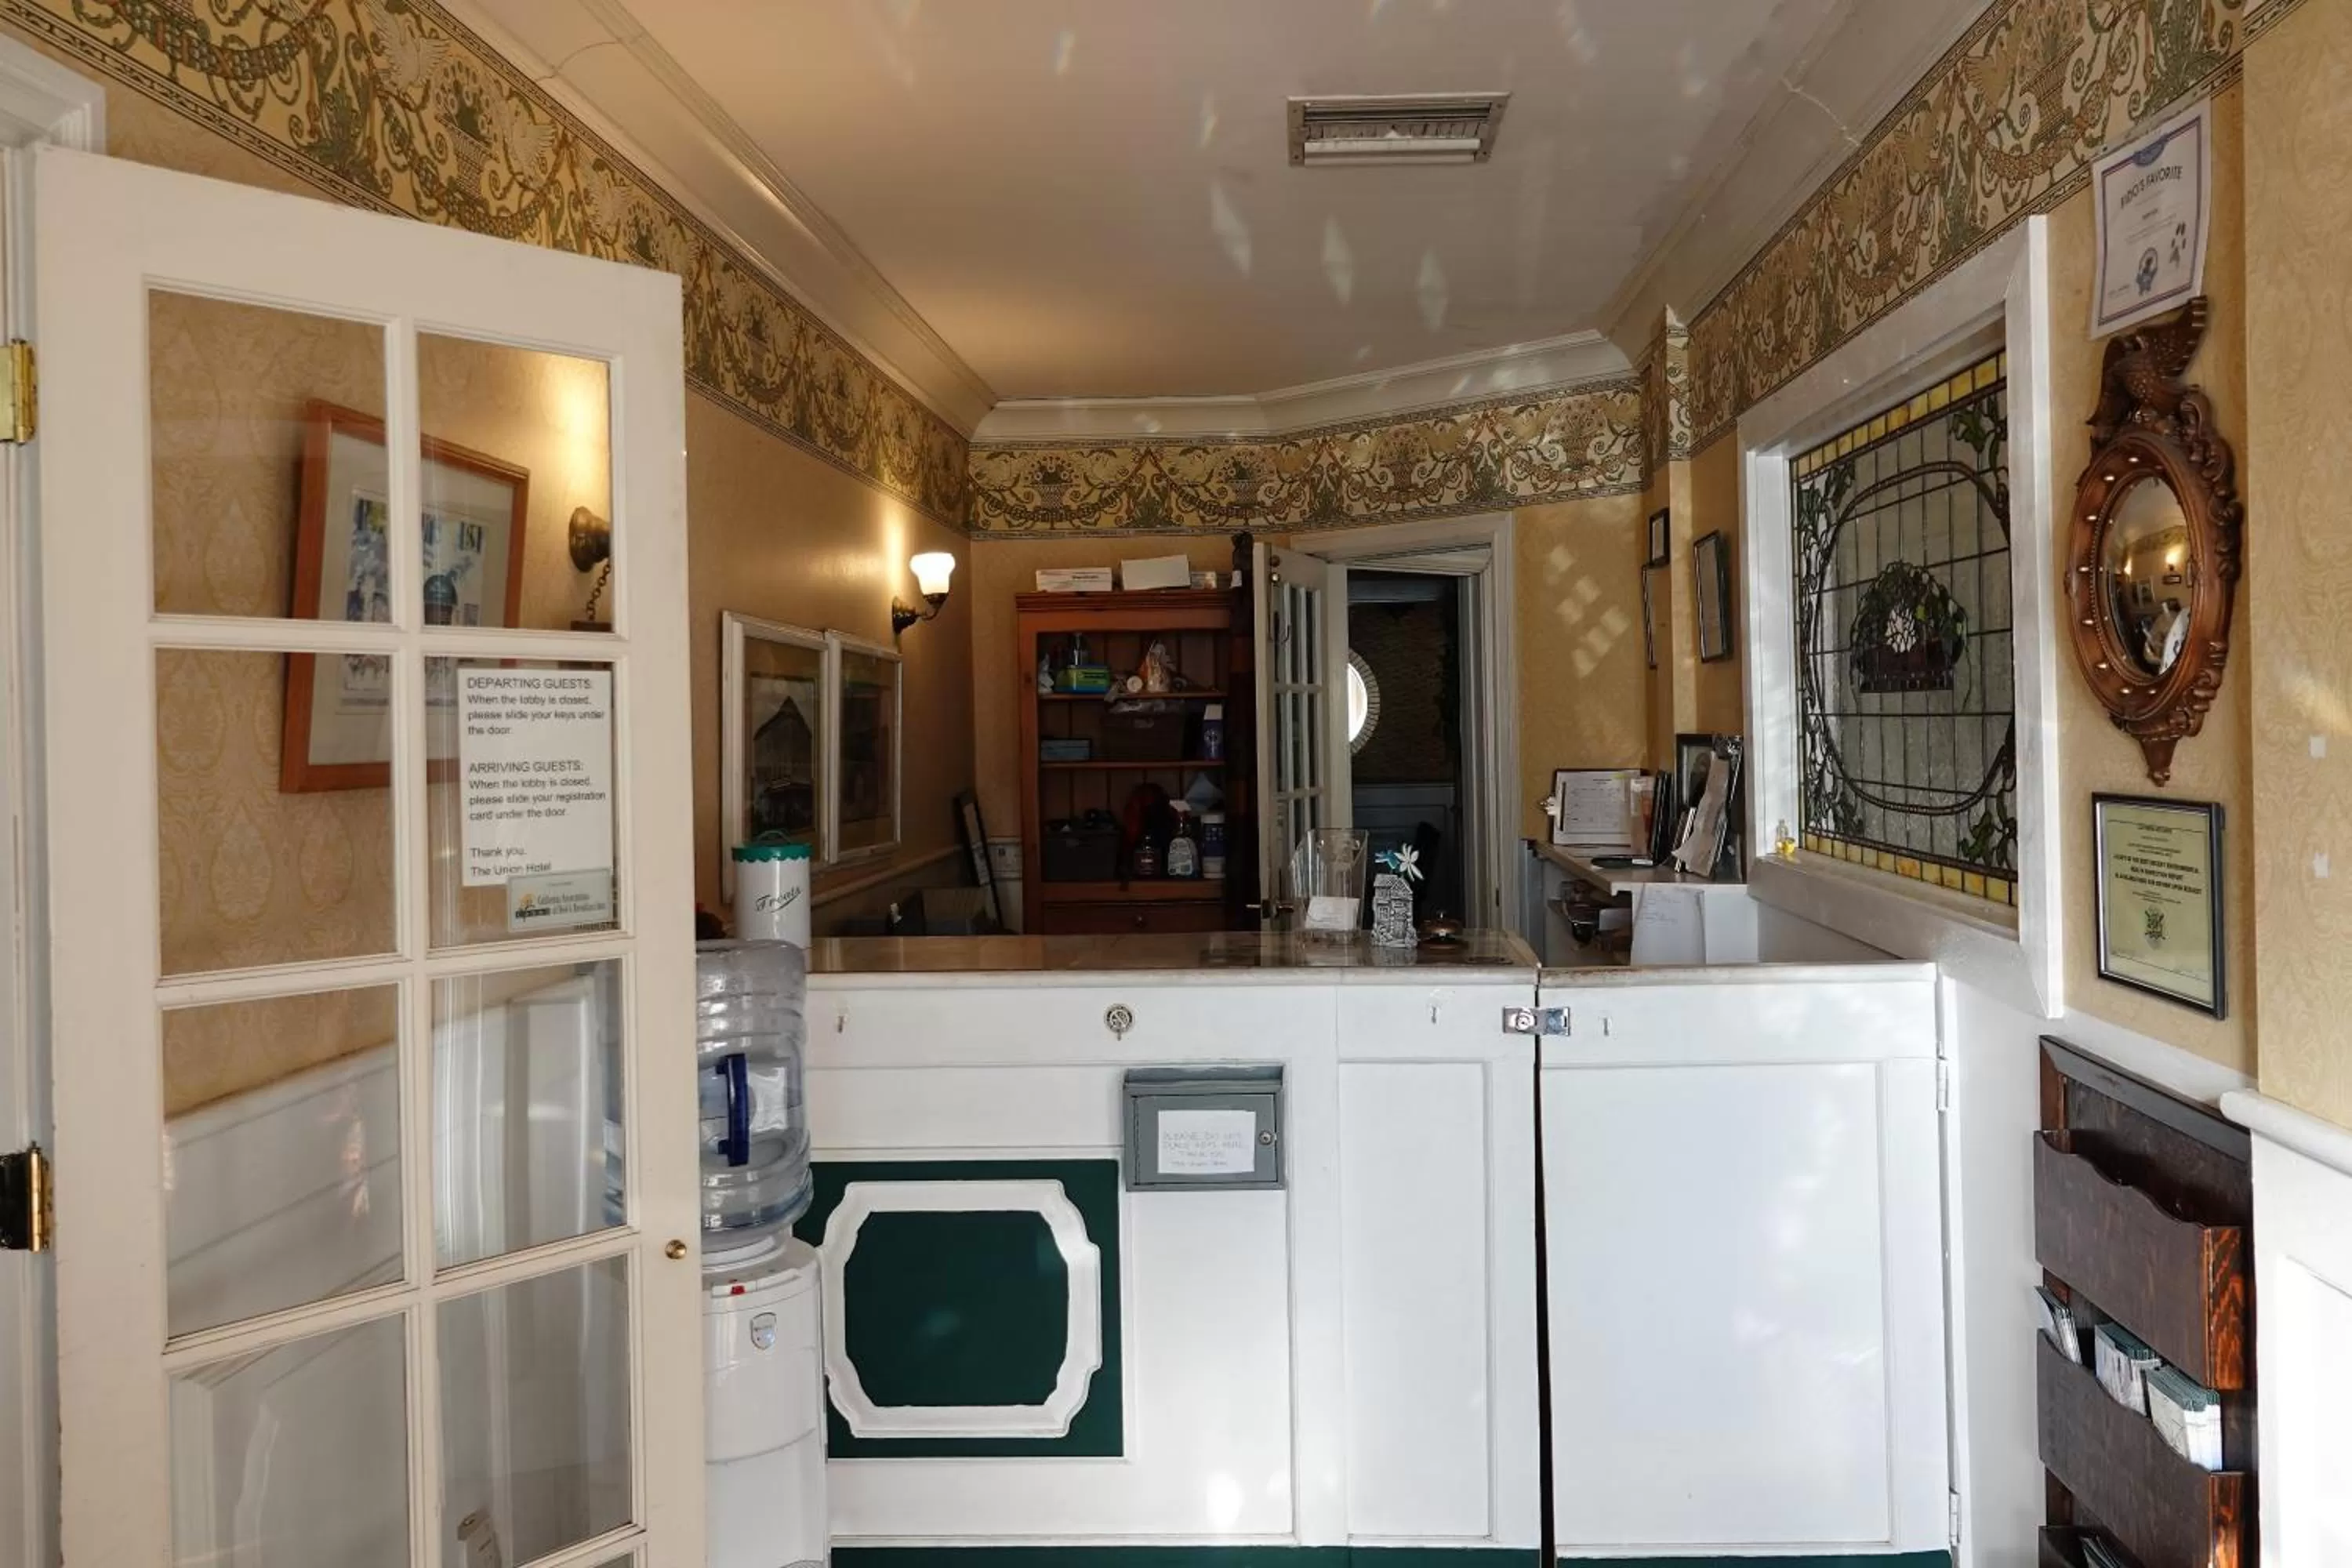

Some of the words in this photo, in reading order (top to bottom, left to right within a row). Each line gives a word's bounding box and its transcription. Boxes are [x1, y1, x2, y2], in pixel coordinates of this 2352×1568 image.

[2146, 165, 2183, 187] FAVORITE
[466, 677, 541, 689] DEPARTING
[467, 695, 499, 705] When
[501, 695, 517, 705] the
[520, 695, 546, 706] lobby
[549, 695, 556, 704] is
[468, 710, 503, 721] please
[506, 710, 528, 719] slide
[531, 711, 552, 721] your
[554, 710, 576, 721] keys
[579, 710, 604, 719] under
[468, 726, 485, 735] the
[470, 760, 530, 773] ARRIVING
[470, 779, 499, 789] When
[503, 779, 518, 788] the
[521, 779, 547, 789] lobby
[550, 778, 557, 787] is
[469, 795, 503, 806] please
[506, 794, 529, 804] slide
[532, 793, 553, 804] your
[555, 792, 606, 804] registration
[470, 811, 493, 821] card
[495, 810, 524, 820] under
[527, 809, 542, 818] the
[470, 848, 503, 858] Thank
[471, 866, 491, 877] The
[495, 864, 523, 876] Union
[526, 862, 552, 873] Hotel
